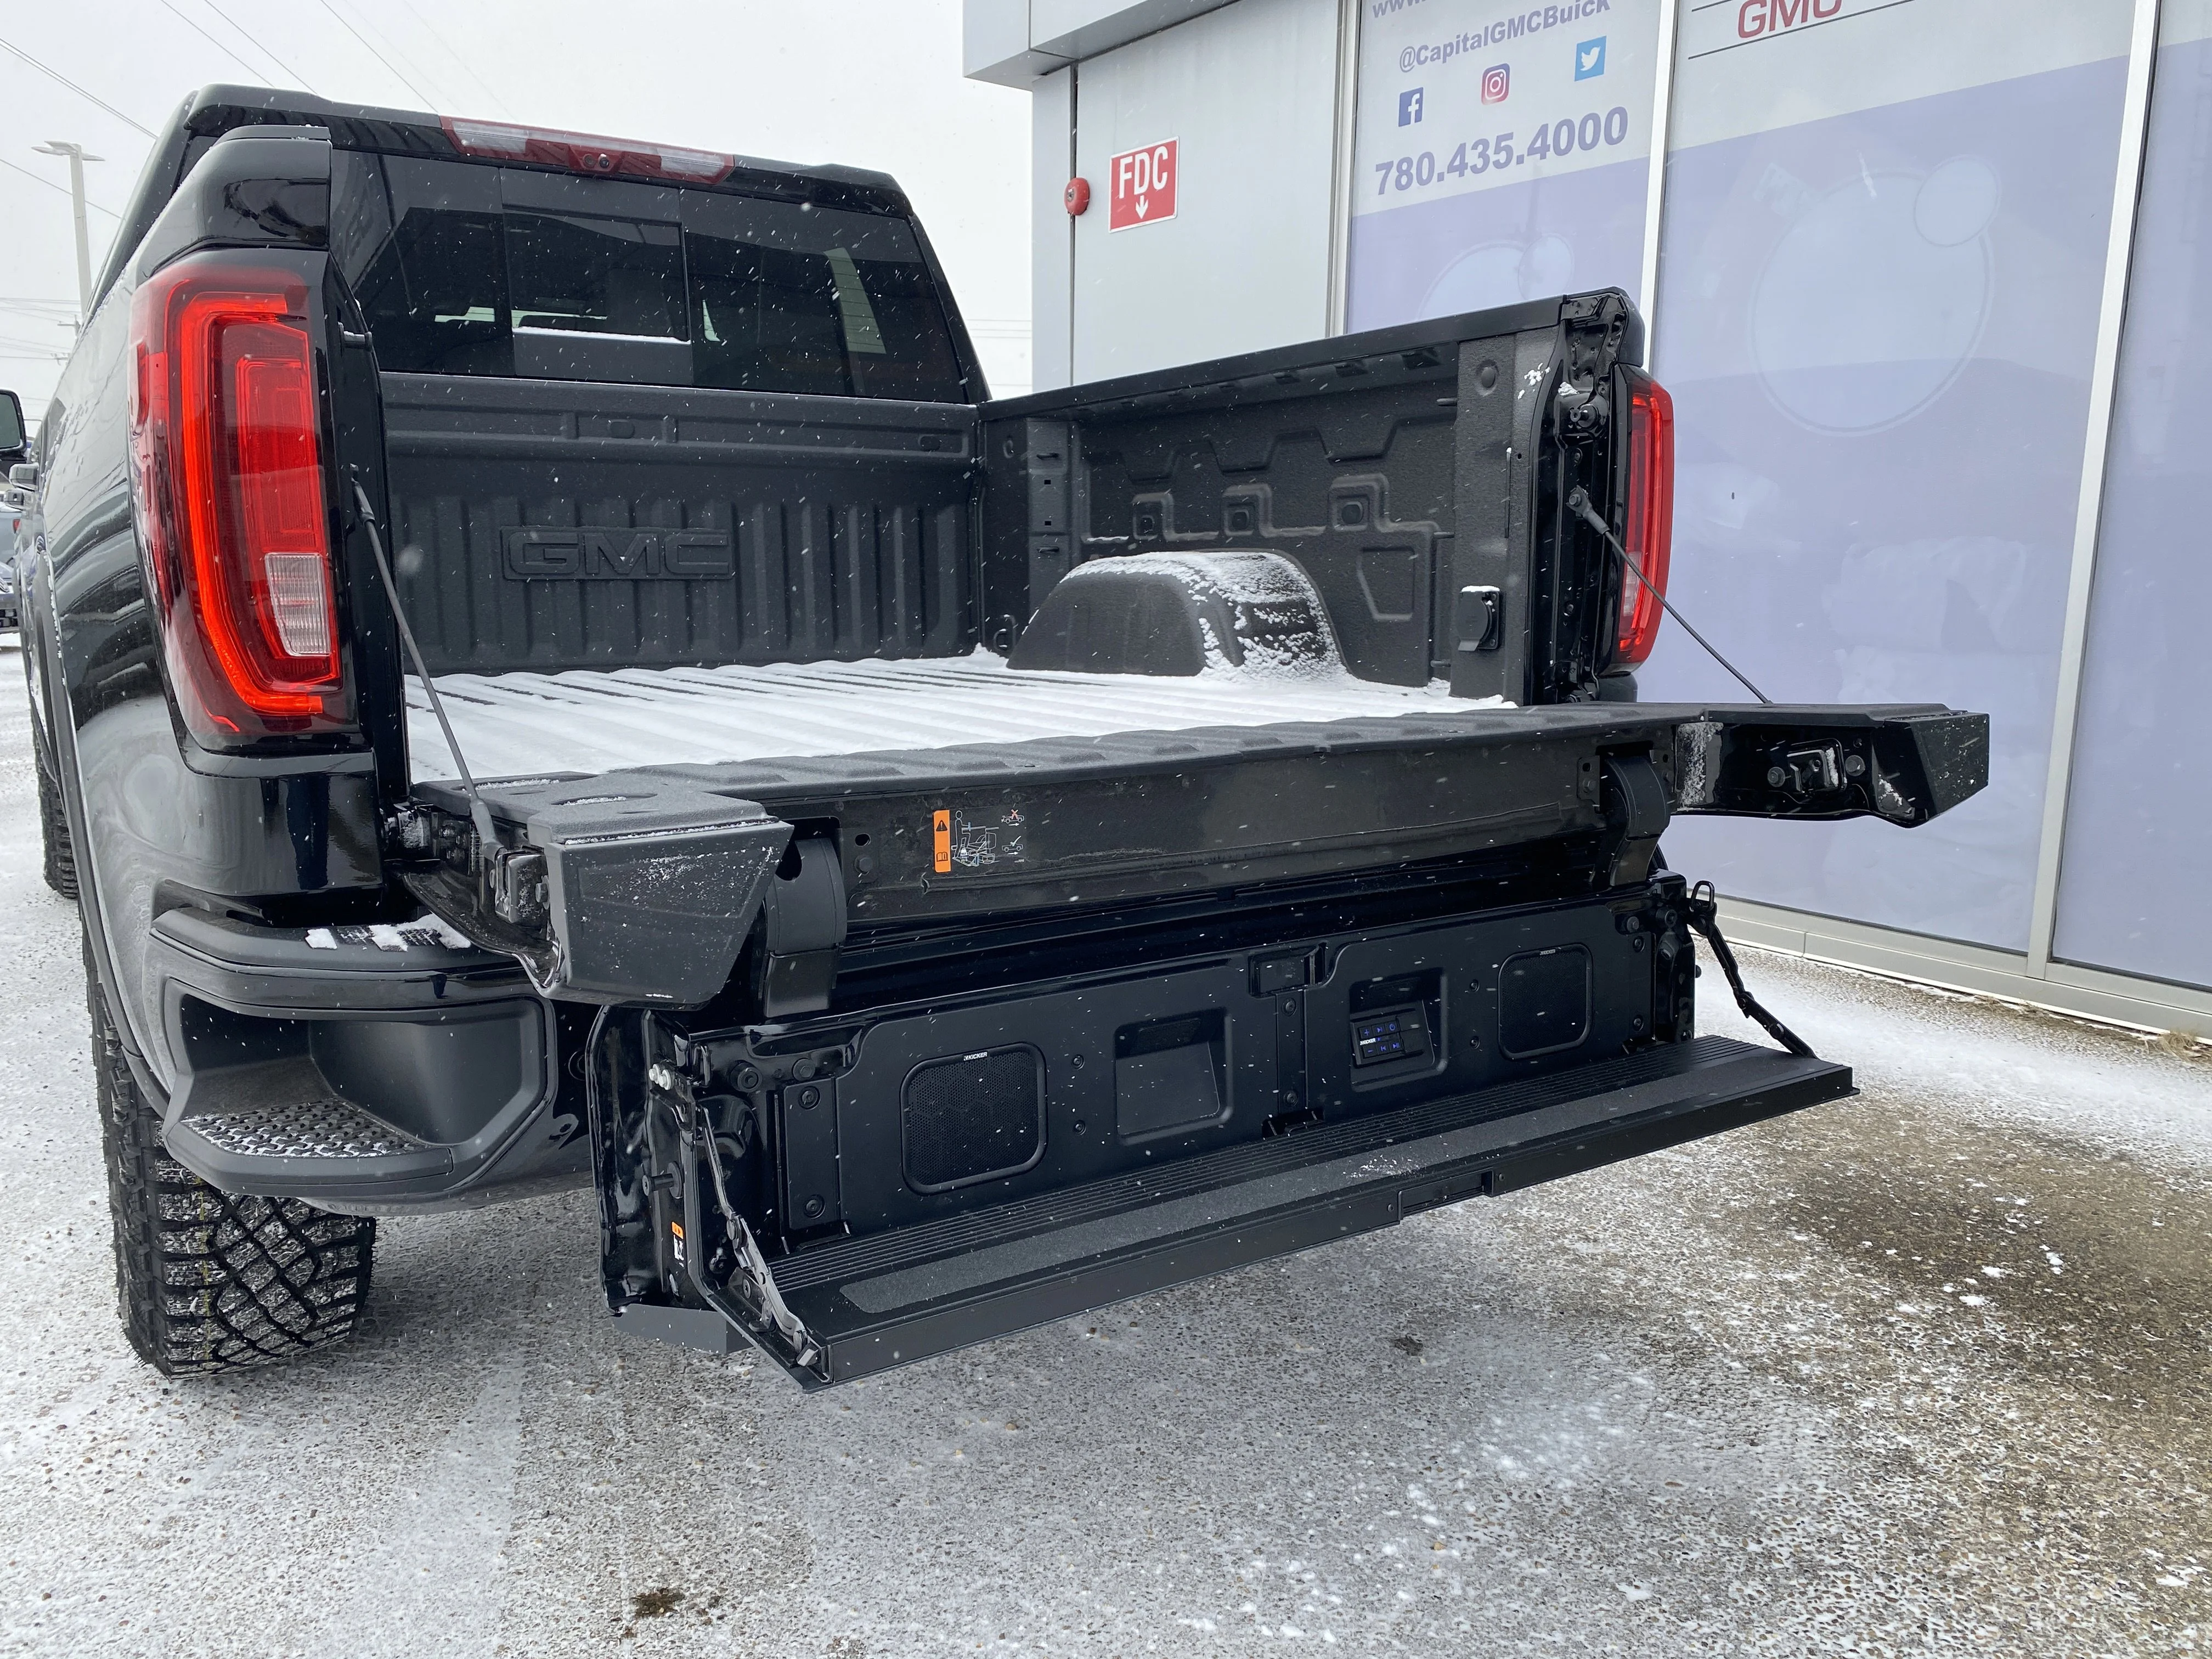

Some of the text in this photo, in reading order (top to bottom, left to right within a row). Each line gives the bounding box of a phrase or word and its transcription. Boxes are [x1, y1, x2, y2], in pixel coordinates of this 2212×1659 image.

[1119, 145, 1168, 199] FDC
[1375, 106, 1628, 195] 780.435.4000
[508, 532, 730, 575] GMC
[968, 1052, 988, 1060] KICKER
